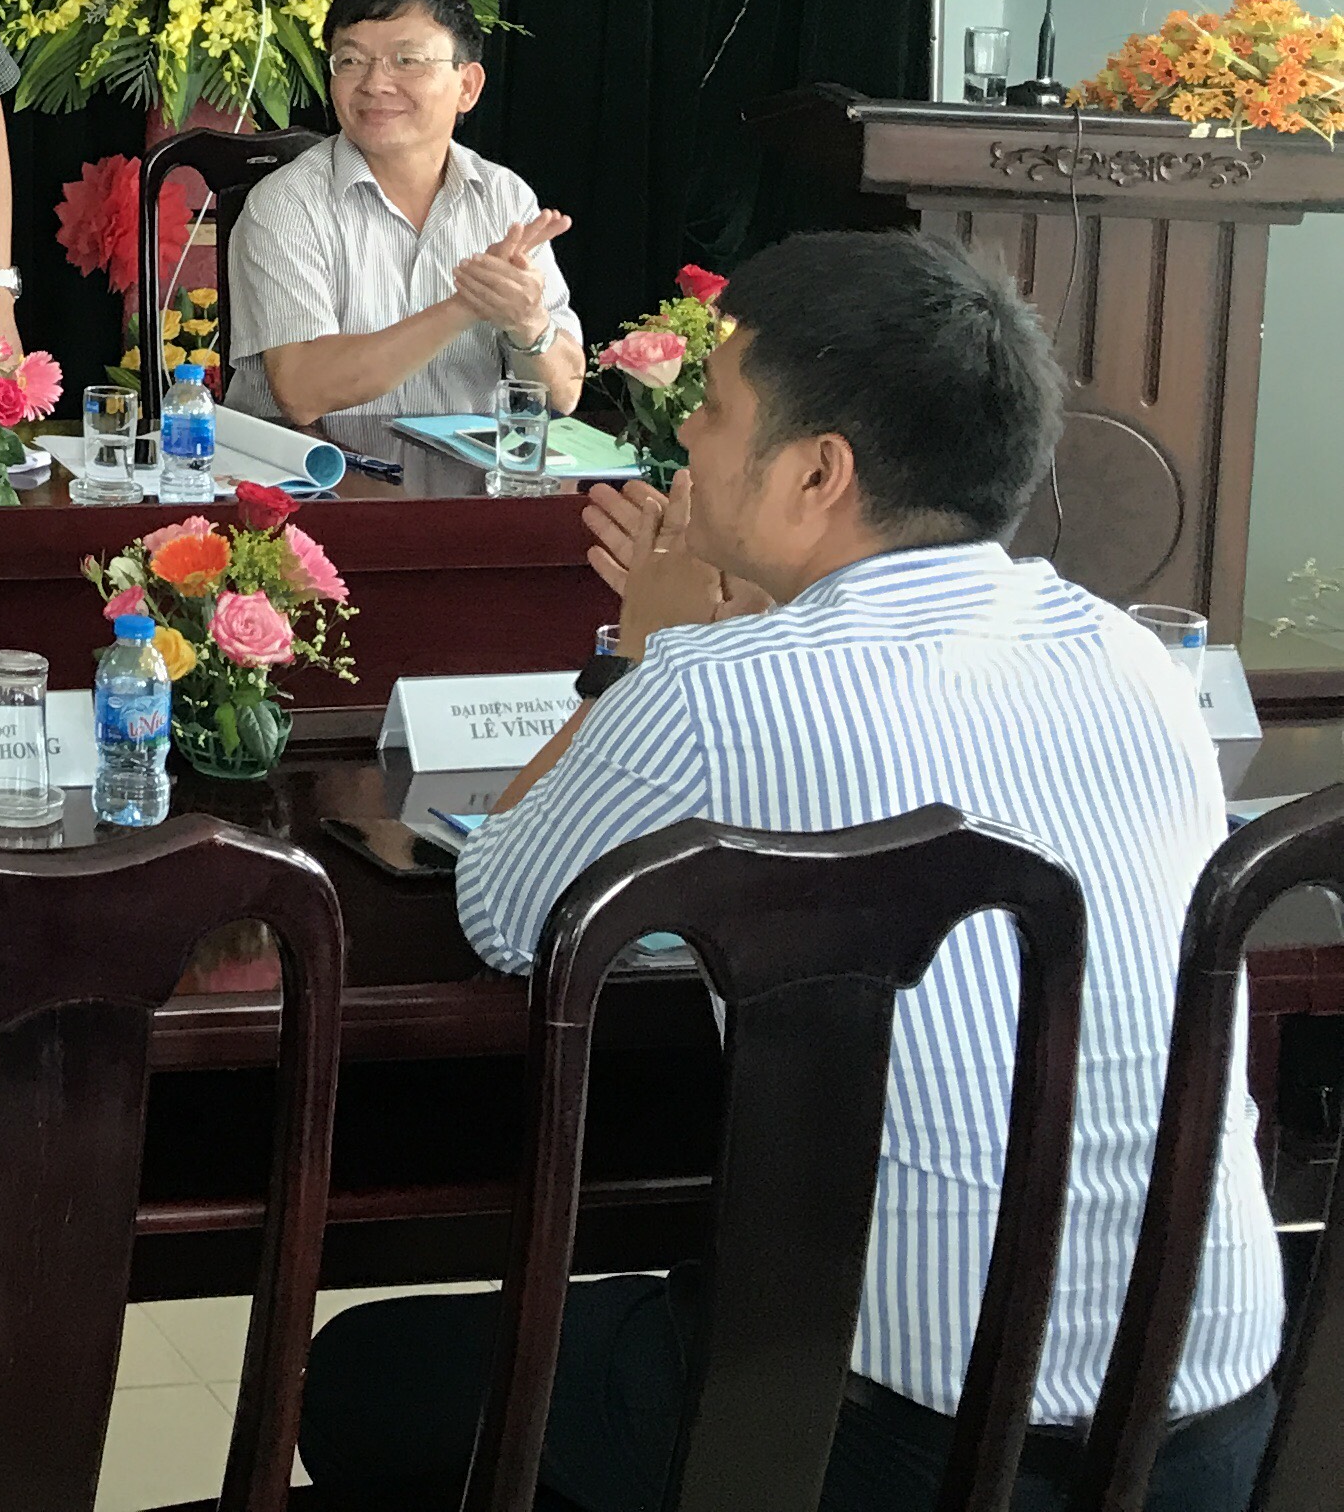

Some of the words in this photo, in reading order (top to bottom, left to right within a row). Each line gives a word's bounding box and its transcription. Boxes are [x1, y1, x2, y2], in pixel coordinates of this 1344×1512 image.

[450, 702, 476, 718] ĐẠI
[470, 718, 498, 739] LÊ
[501, 717, 555, 737] VĨNH
